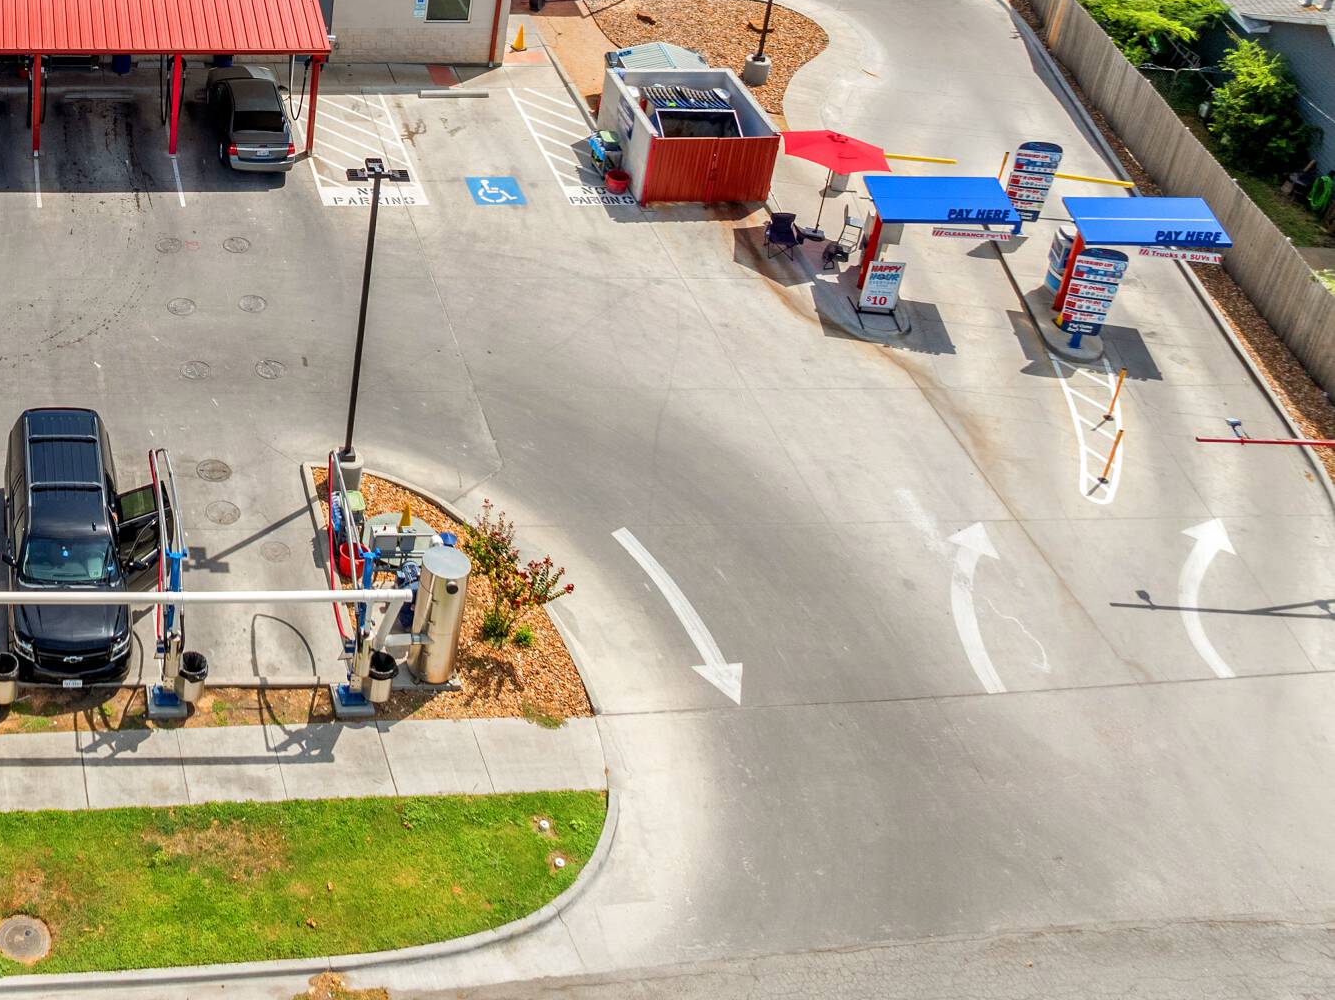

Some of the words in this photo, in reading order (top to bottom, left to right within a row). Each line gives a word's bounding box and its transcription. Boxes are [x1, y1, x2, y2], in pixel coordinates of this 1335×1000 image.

[580, 186, 607, 195] NO
[569, 196, 634, 204] PARKING
[947, 208, 973, 219] PAY
[975, 208, 1011, 219] HERE
[1155, 230, 1183, 241] PAY
[1185, 231, 1222, 241] HERE
[1151, 250, 1178, 259] Trucks
[871, 265, 902, 273] HAPPY
[869, 273, 901, 281] HOUR
[866, 295, 888, 306] $10
